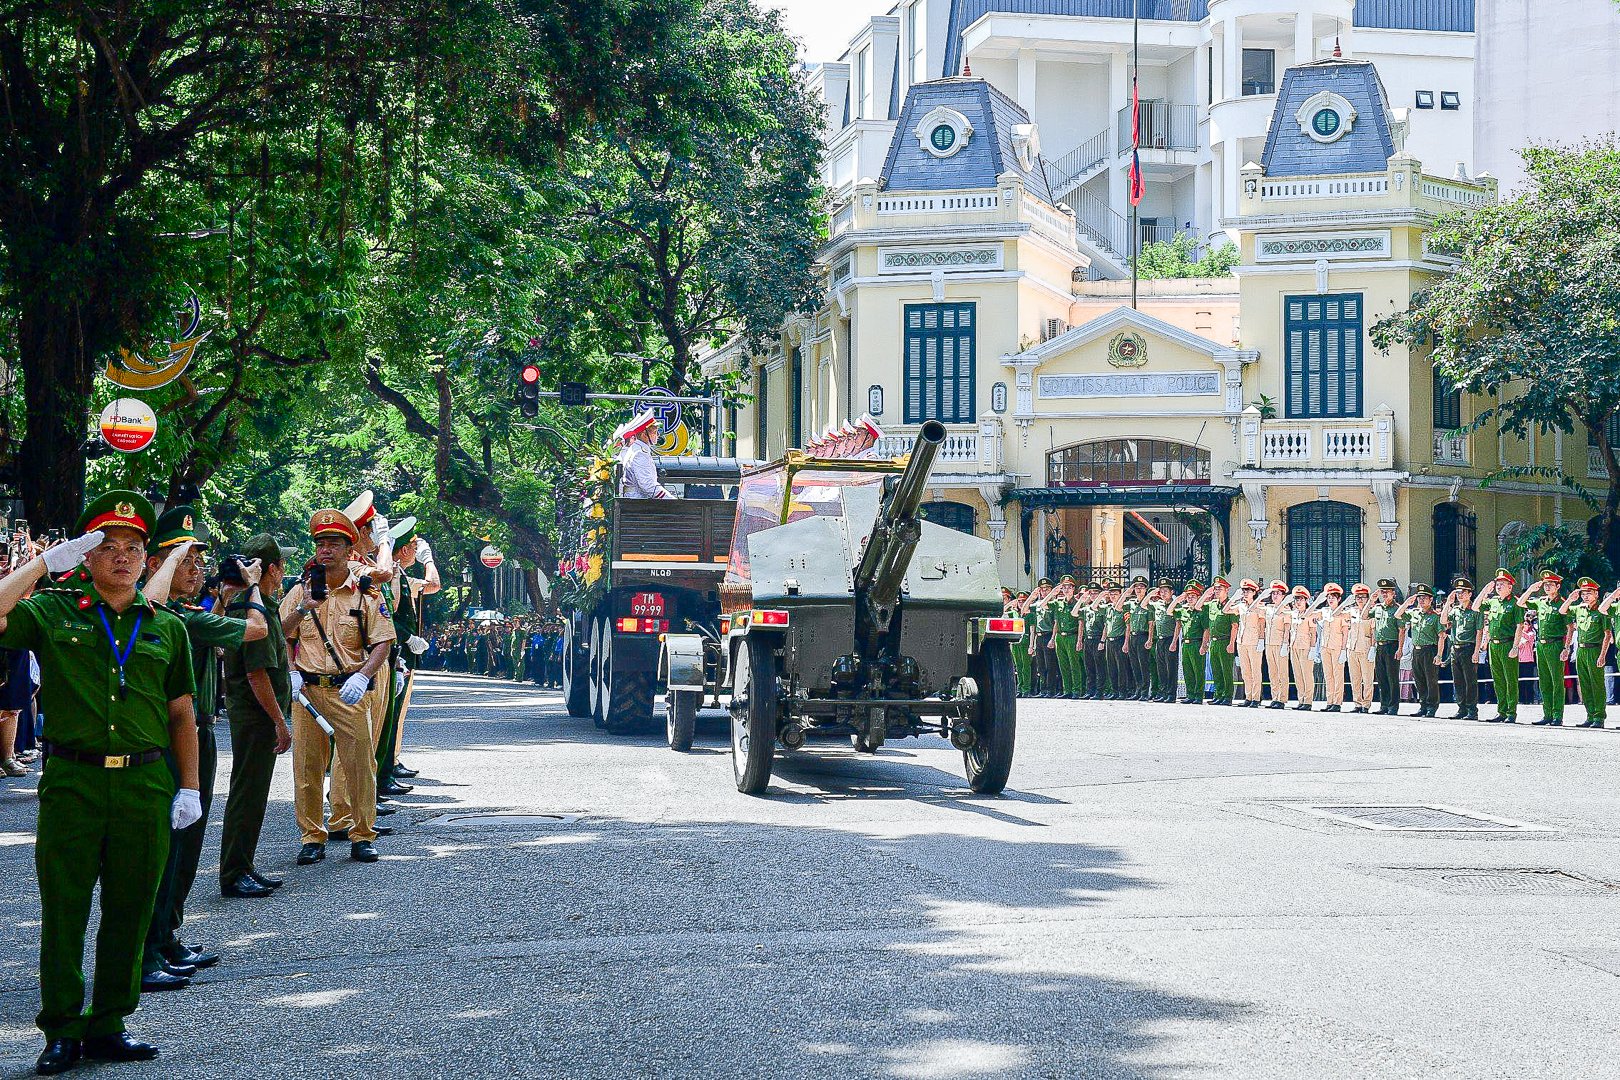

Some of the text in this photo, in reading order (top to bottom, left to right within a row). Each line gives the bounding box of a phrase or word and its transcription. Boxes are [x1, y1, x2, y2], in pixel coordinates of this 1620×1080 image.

[1167, 376, 1216, 391] POLICE
[109, 415, 142, 424] HDBank
[650, 569, 672, 577] NLQĐ
